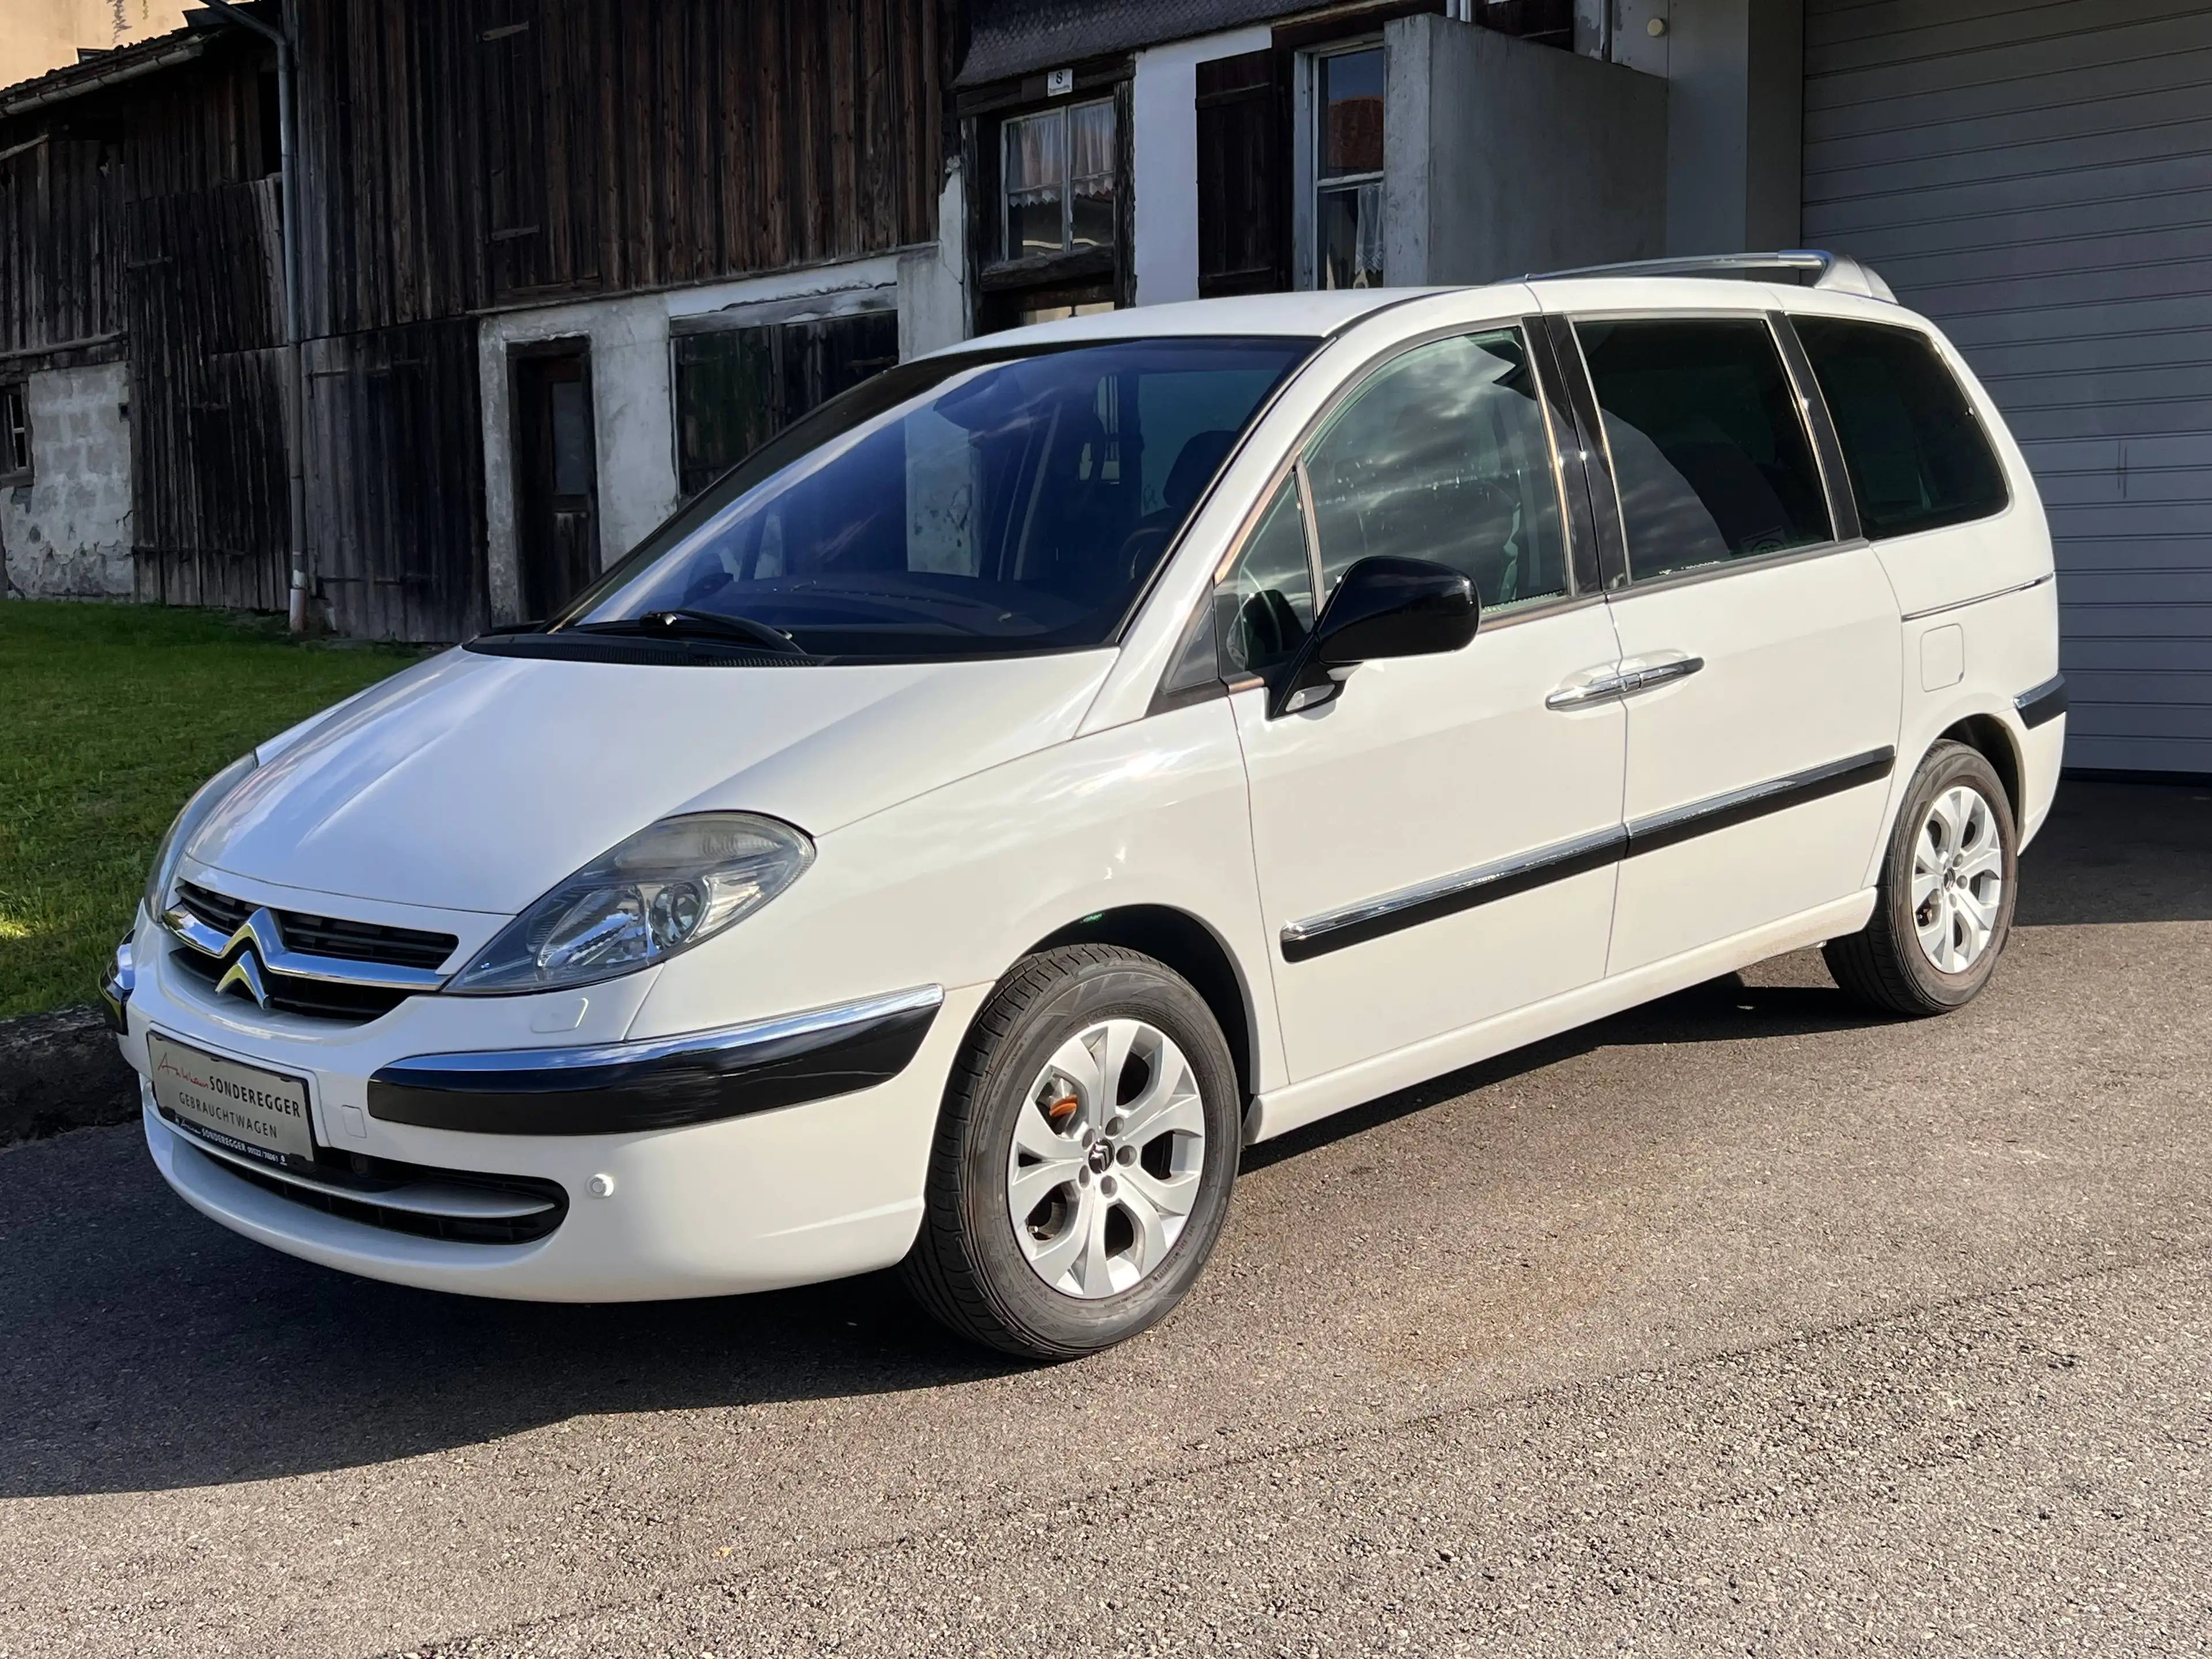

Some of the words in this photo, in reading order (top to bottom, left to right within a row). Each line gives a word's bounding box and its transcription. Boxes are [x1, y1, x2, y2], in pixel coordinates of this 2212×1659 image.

[1056, 71, 1063, 84] 8
[209, 1076, 300, 1118] SONDEREGGER
[179, 1092, 277, 1139] GEBRAUCHTWAGEN
[202, 1127, 247, 1151] SONDEREGGER
